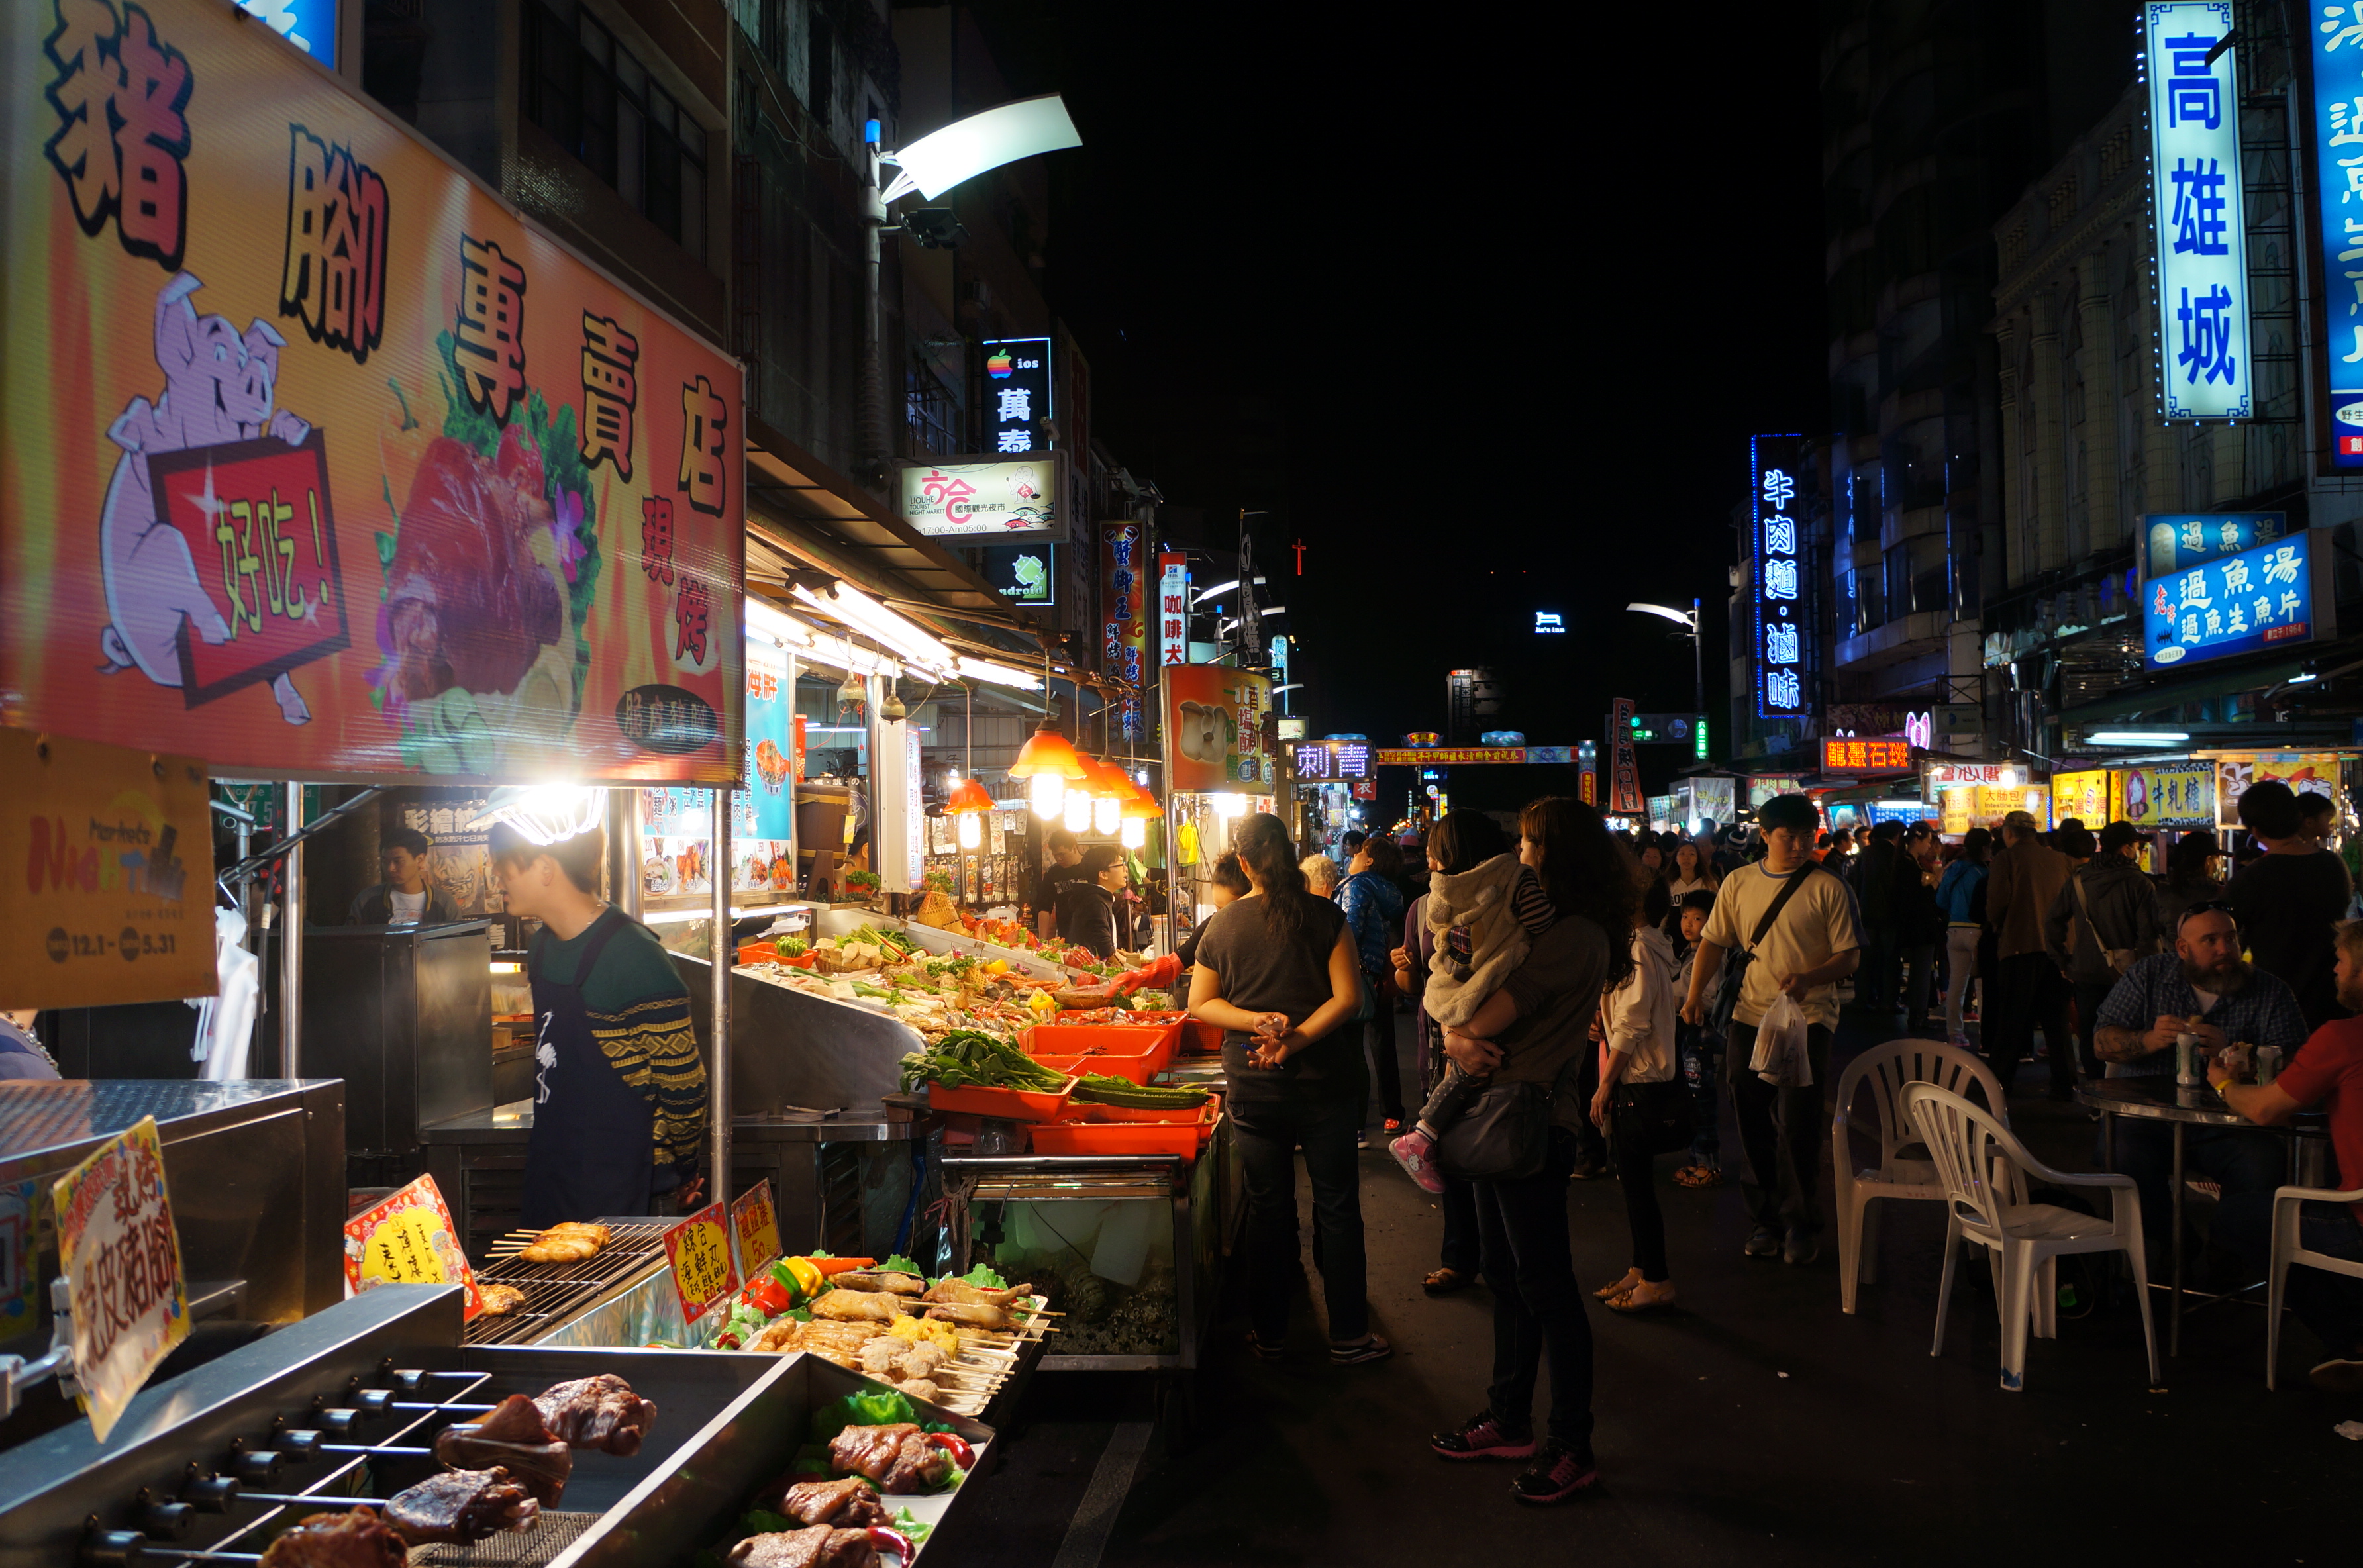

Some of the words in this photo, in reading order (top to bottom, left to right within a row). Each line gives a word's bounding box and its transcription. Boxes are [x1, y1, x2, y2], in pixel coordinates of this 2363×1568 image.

[2164, 32, 2235, 387] 高雄城
[1017, 358, 1039, 369] ios
[955, 503, 1005, 513] 國際觀光夜市
[917, 524, 987, 534] 17:00-Am05:00
[999, 585, 1043, 596] ndroid
[2179, 546, 2303, 611] 過魚湯
[2181, 589, 2301, 644] 過魚生魚片
[1297, 744, 1368, 779] 刺青
[752, 1240, 765, 1264] 50
